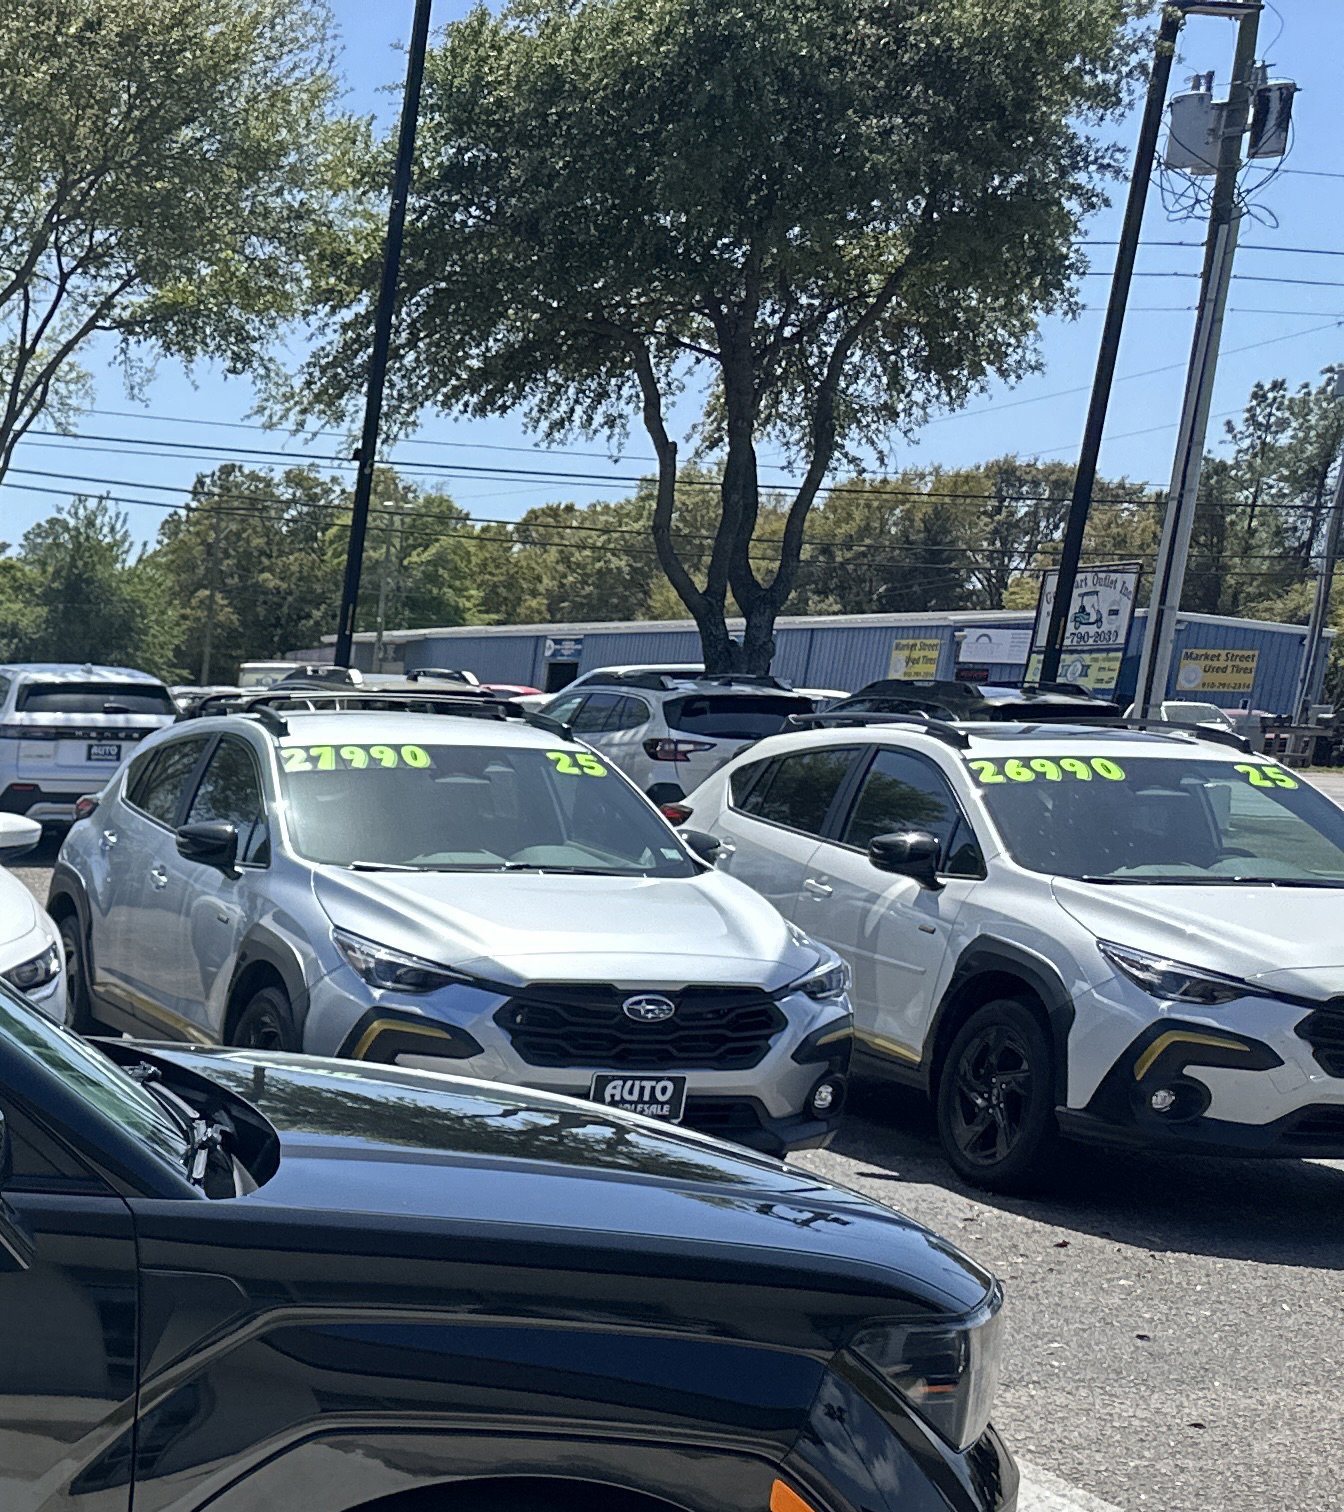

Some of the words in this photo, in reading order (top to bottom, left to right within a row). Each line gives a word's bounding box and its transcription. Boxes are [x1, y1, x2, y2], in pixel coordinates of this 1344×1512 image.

[1183, 651, 1221, 662] Market
[1223, 651, 1256, 663] Street
[1203, 664, 1229, 674] Used
[1230, 664, 1254, 674] Tires
[281, 745, 432, 772] 27990
[546, 751, 607, 777] 25
[969, 757, 1126, 784] 26990
[1234, 764, 1298, 789] 25
[604, 1079, 674, 1105] AUTO
